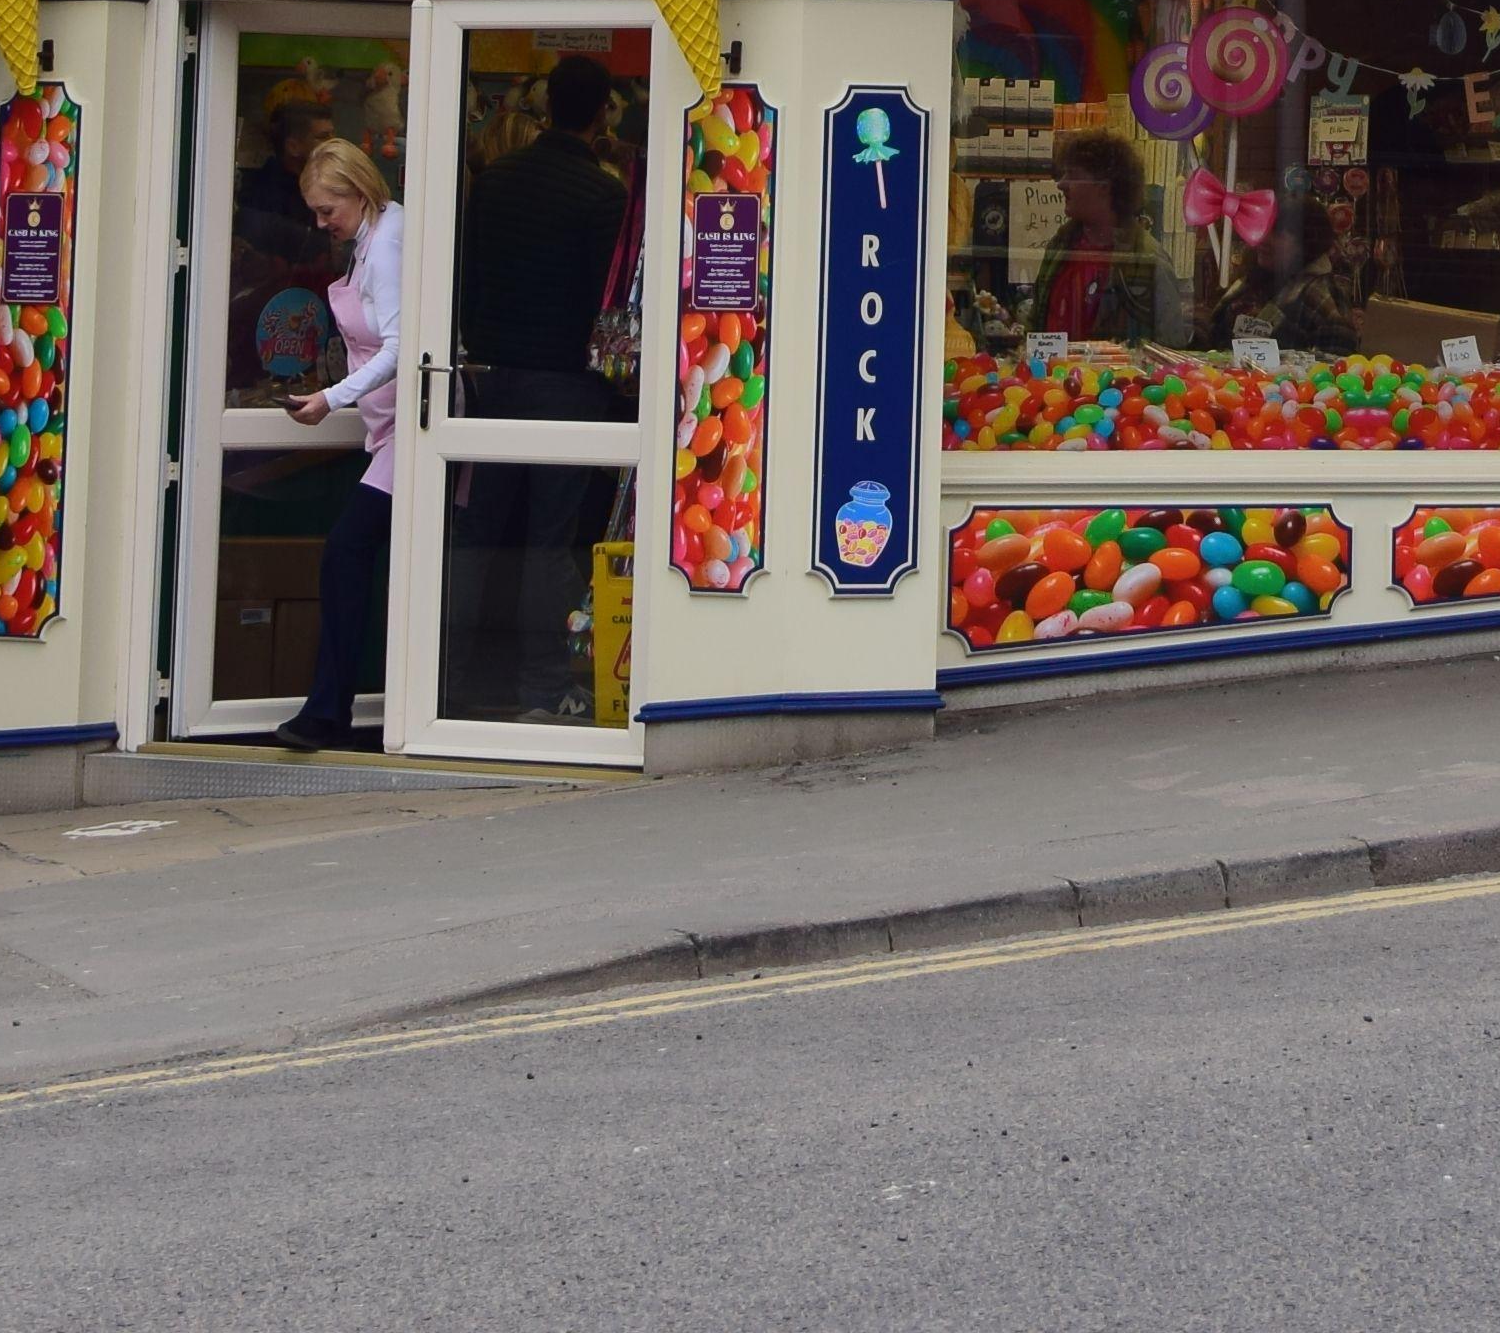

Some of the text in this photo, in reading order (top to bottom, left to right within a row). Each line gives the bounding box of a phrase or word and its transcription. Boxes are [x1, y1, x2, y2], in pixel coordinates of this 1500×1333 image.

[8, 229, 29, 237] CASH
[39, 229, 58, 237] KING
[697, 232, 756, 241] CASH IS KING
[855, 234, 884, 442] ROCK
